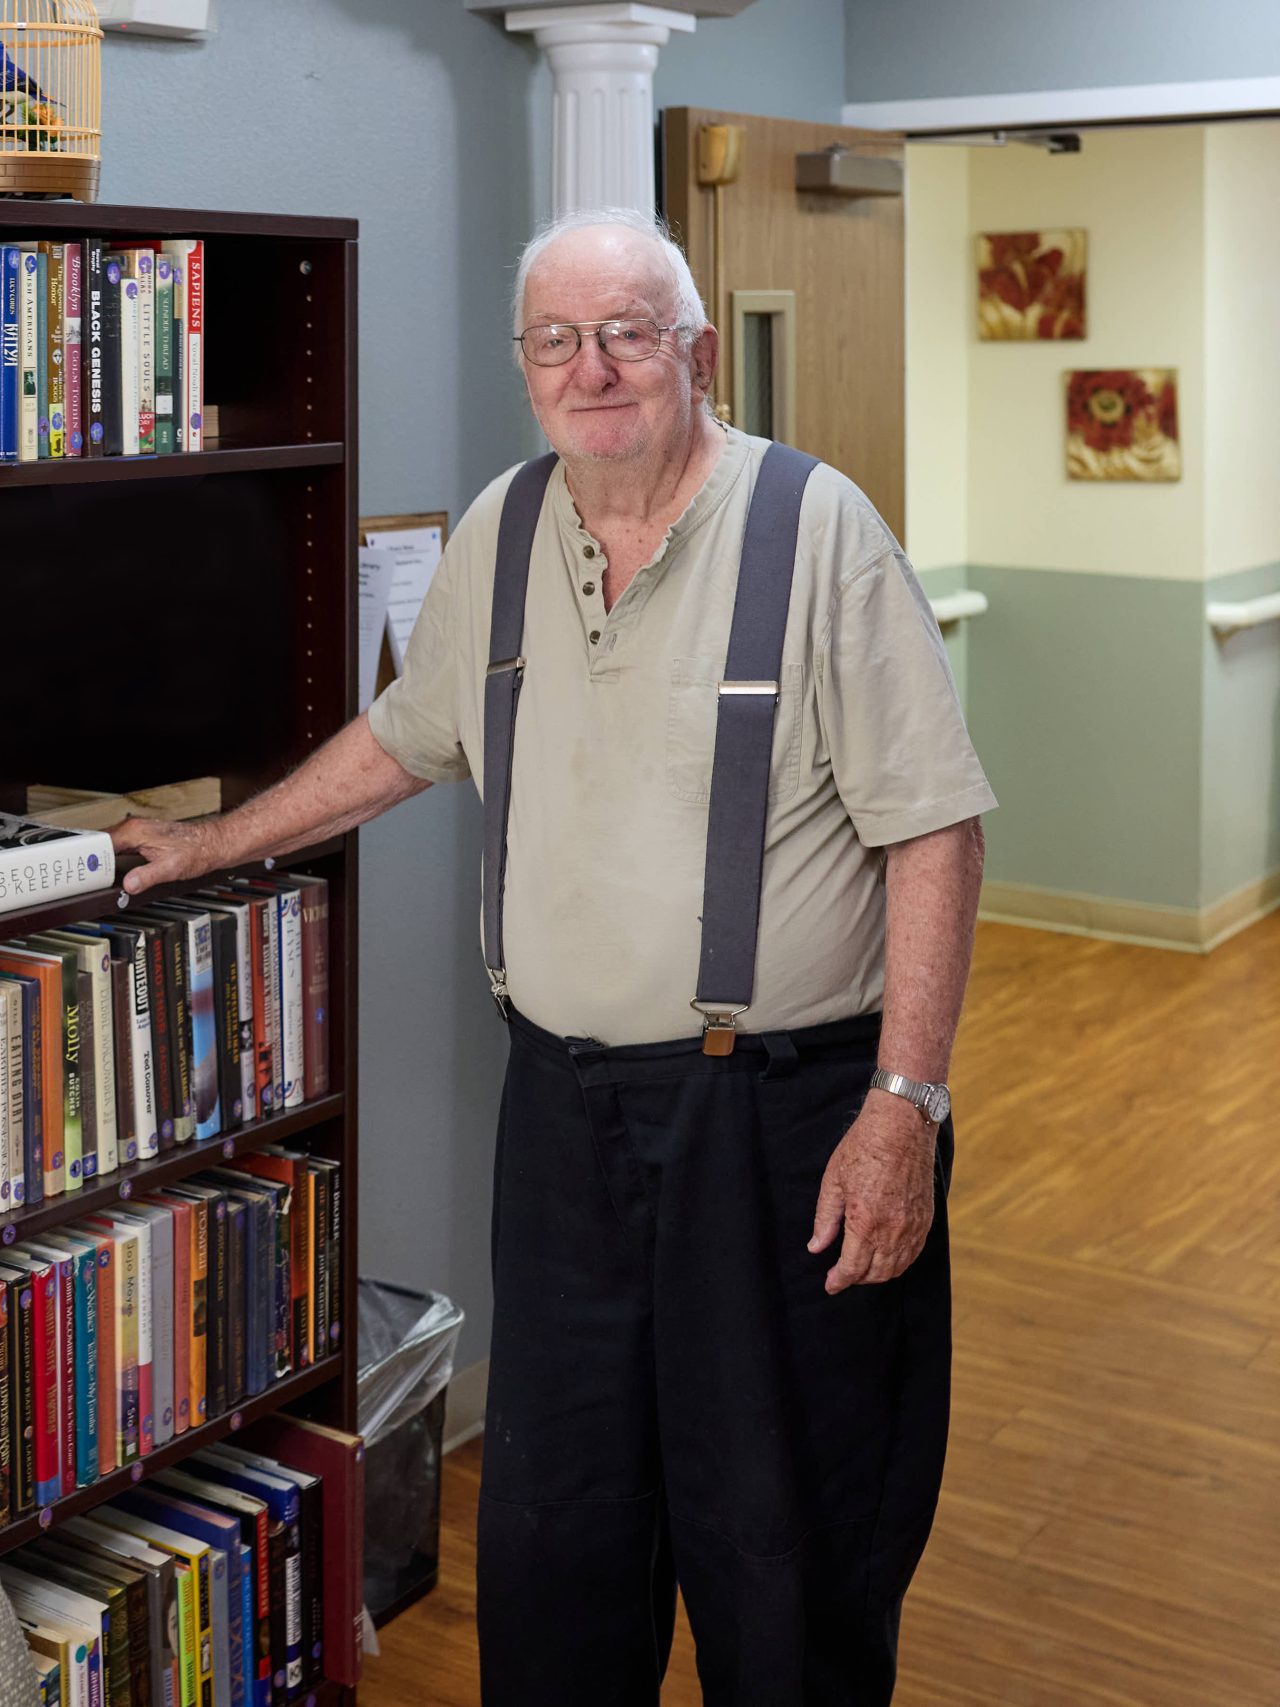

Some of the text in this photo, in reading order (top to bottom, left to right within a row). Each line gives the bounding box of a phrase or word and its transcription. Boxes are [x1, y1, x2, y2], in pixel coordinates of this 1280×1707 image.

[71, 257, 80, 311] Brooklyn
[192, 262, 200, 327] SAPIENS
[4, 324, 18, 366] KATYA
[27, 299, 35, 357] AMERICANS
[91, 291, 100, 413] BLACK GENESIS
[65, 1005, 80, 1064] Molly
[143, 1051, 151, 1070] Ted
[10, 1035, 24, 1126] EATING DIRT
[68, 1073, 76, 1116] BUTCHER
